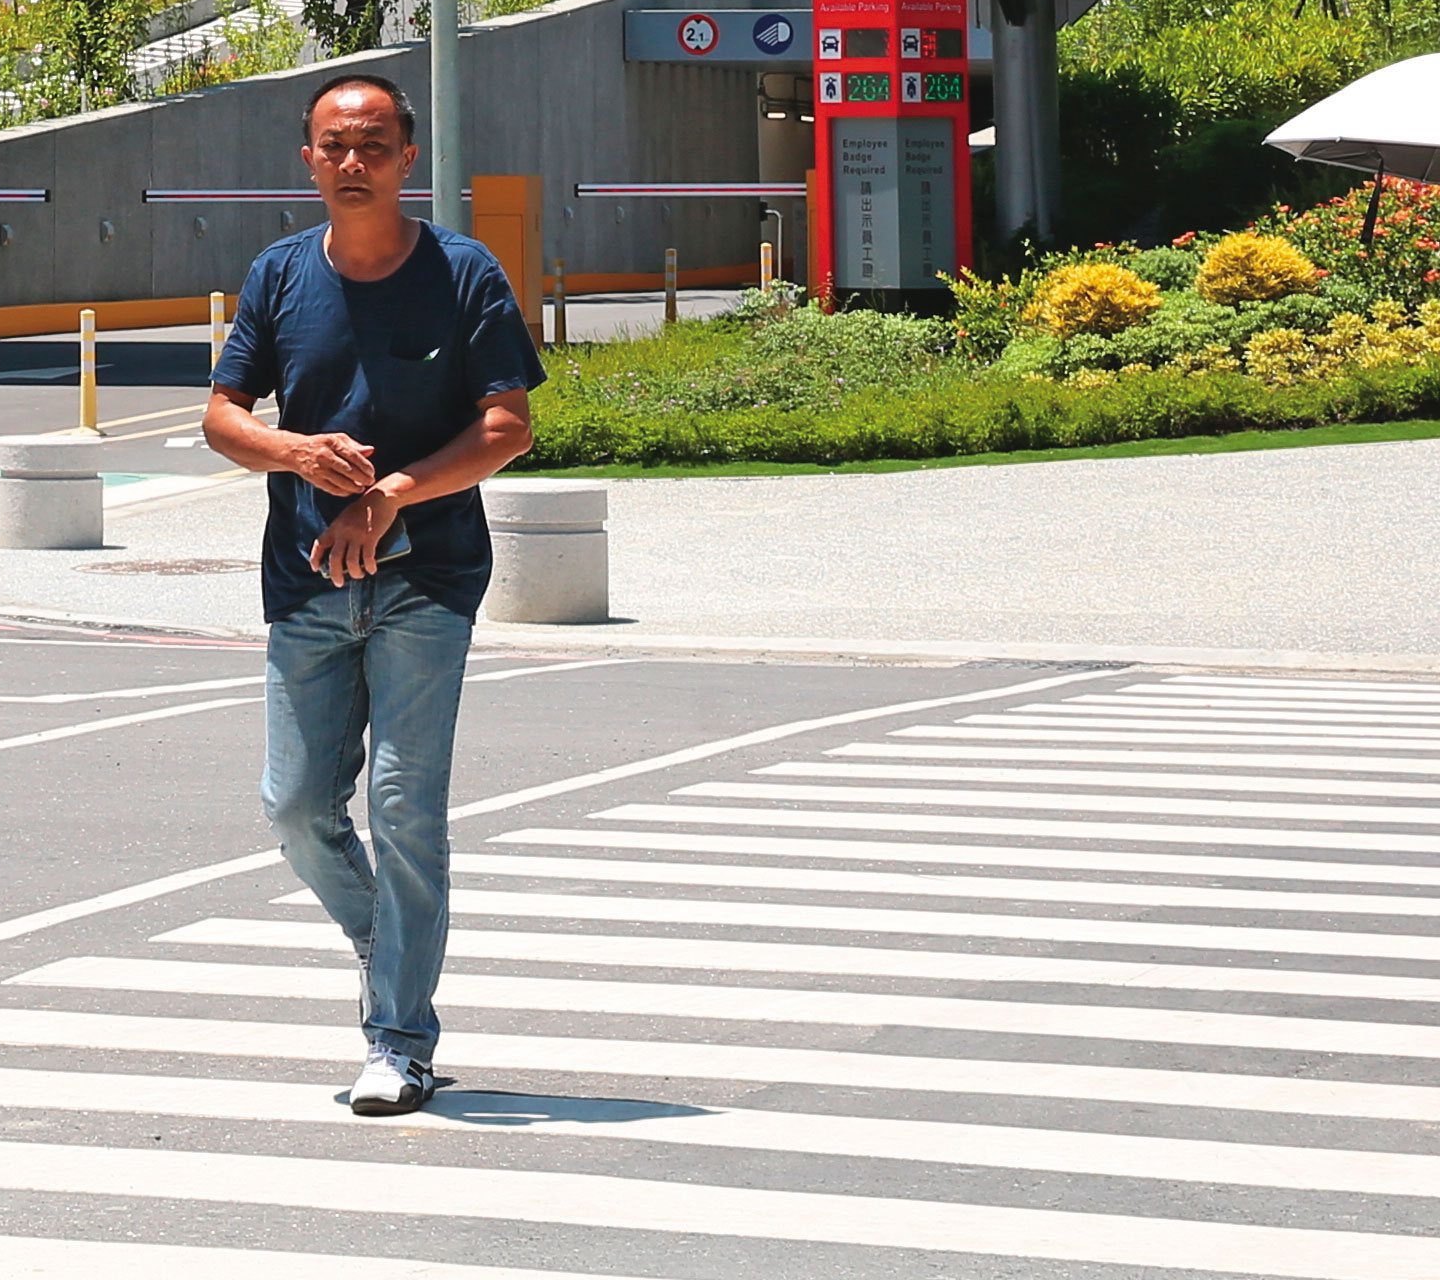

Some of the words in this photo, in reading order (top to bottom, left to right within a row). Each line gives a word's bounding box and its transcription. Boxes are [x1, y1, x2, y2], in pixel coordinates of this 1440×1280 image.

[820, 1, 856, 12] Available
[858, 1, 889, 14] Parking
[901, 1, 934, 11] Available
[935, 1, 961, 14] Parking
[848, 75, 889, 101] 264
[924, 74, 960, 100] 264
[843, 139, 887, 150] Employee
[905, 139, 945, 149] Employee
[843, 152, 872, 163] Badge
[905, 152, 931, 163] Badge
[843, 165, 885, 176] Required
[905, 165, 943, 175] Required
